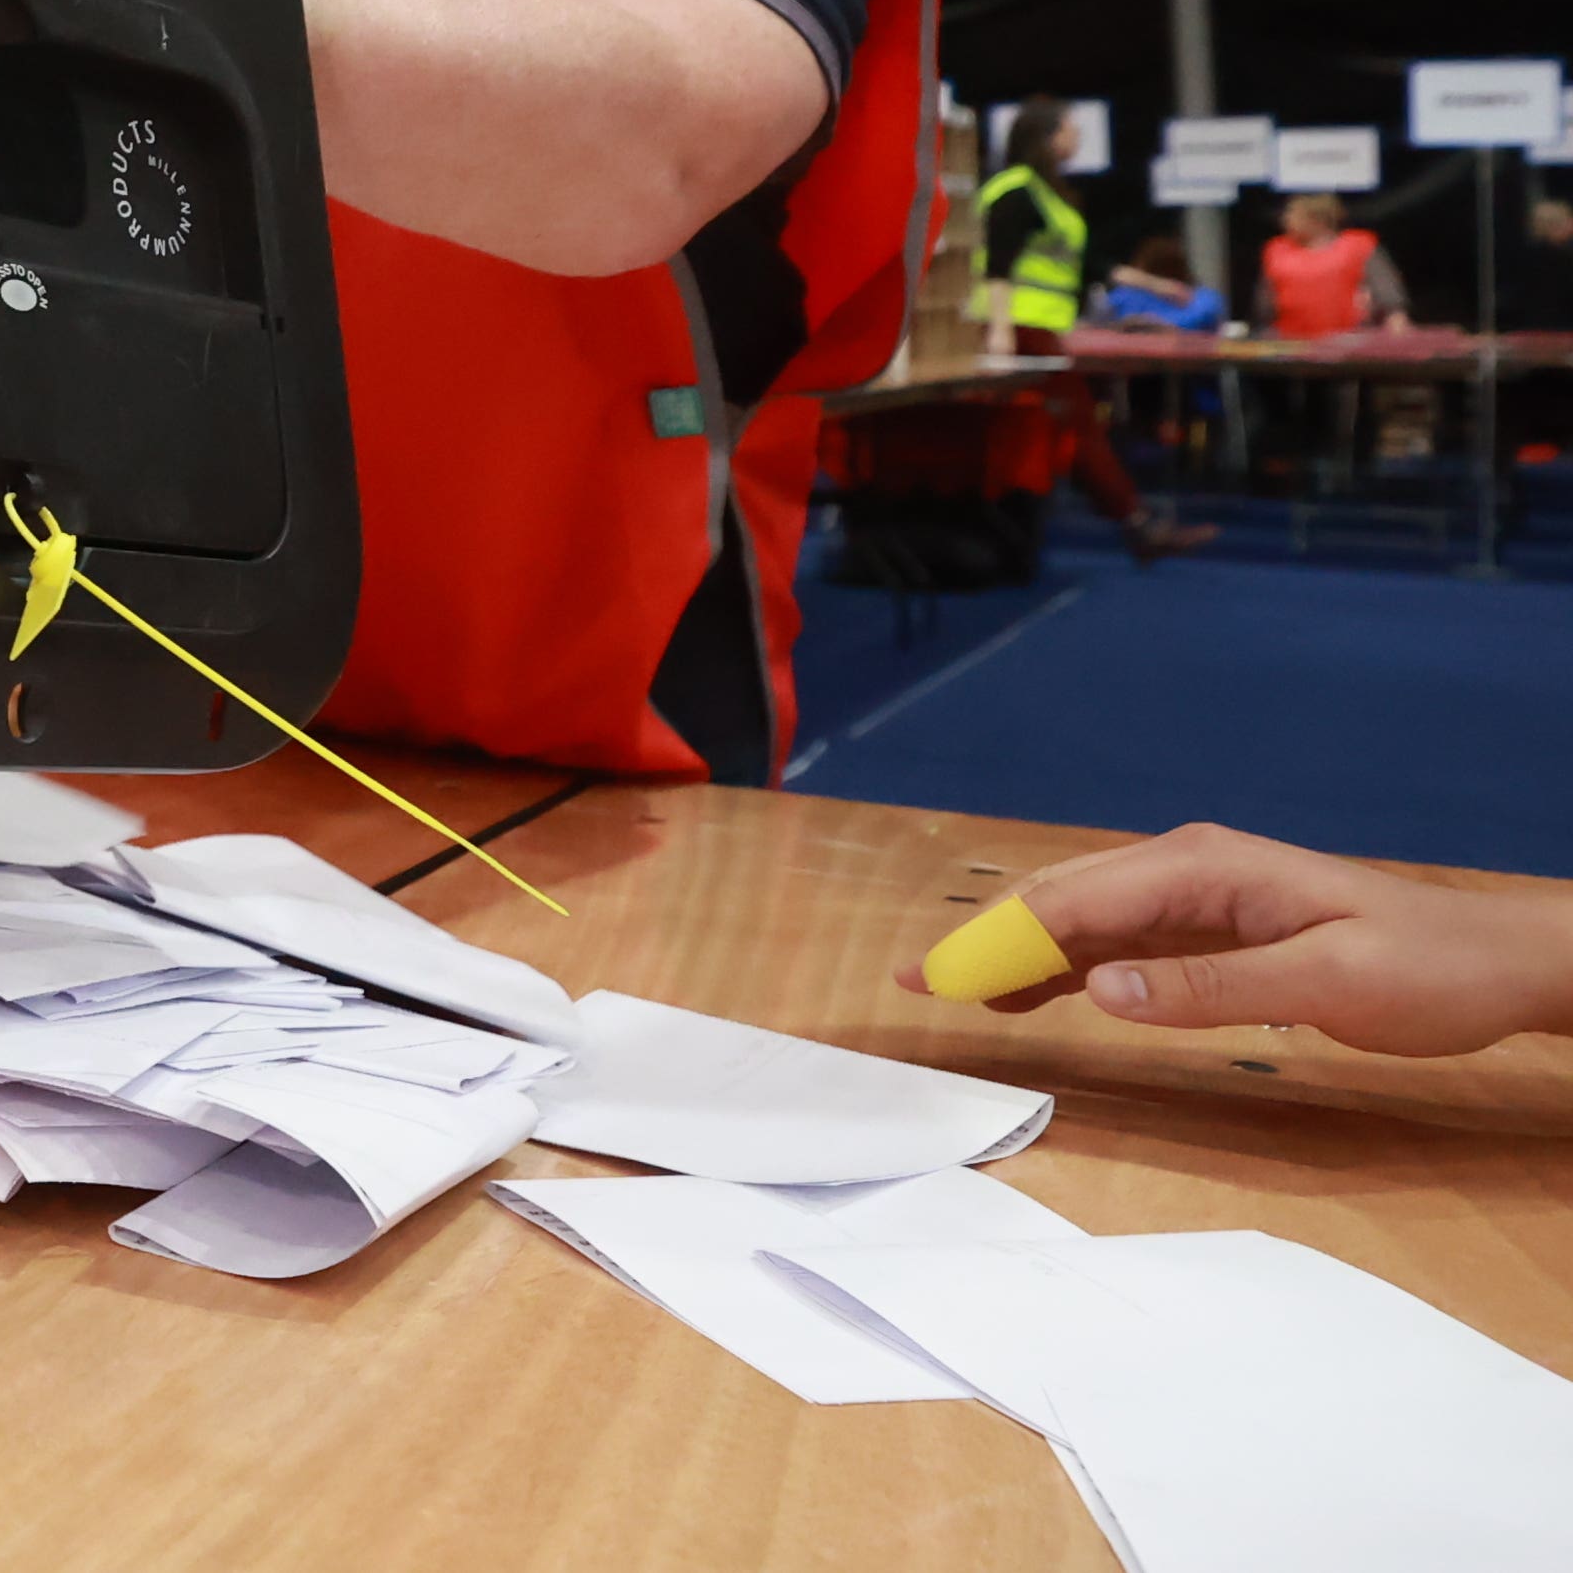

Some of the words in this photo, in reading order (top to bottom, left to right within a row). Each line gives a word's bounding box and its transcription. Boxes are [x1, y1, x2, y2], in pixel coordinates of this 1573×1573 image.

[112, 120, 155, 250] PRODUCTS
[148, 154, 191, 257] MILLENNIUM
[9, 263, 26, 277] TO
[27, 270, 49, 309] OPEN
